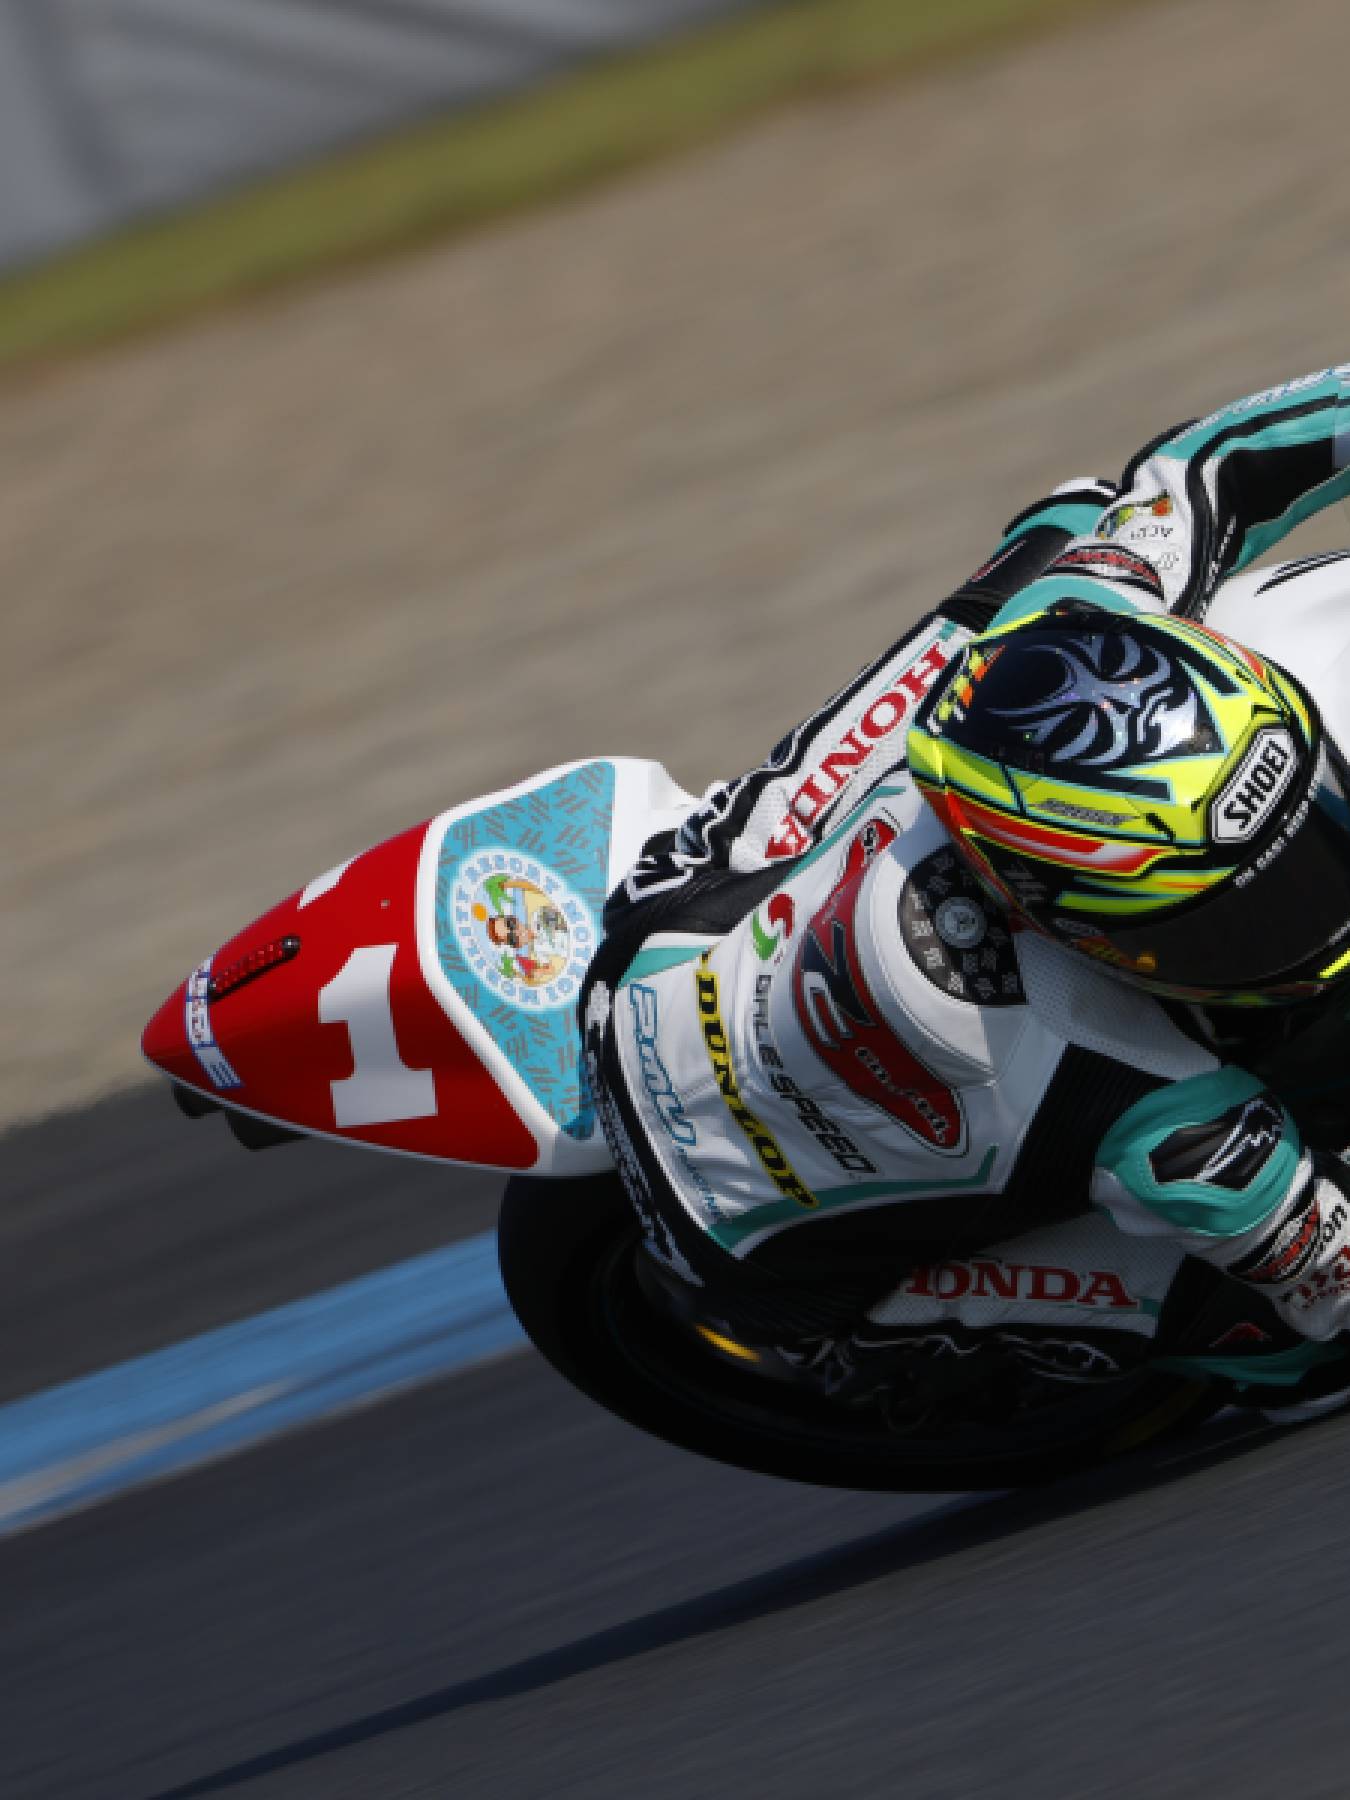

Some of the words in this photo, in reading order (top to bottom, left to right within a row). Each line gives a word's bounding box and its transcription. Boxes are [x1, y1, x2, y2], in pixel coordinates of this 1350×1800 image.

[764, 642, 949, 859] HONDA
[1224, 738, 1291, 833] SHOEI
[317, 943, 439, 1129] 1
[698, 976, 816, 1206] DUNLOP
[769, 1065, 878, 1175] SPEED
